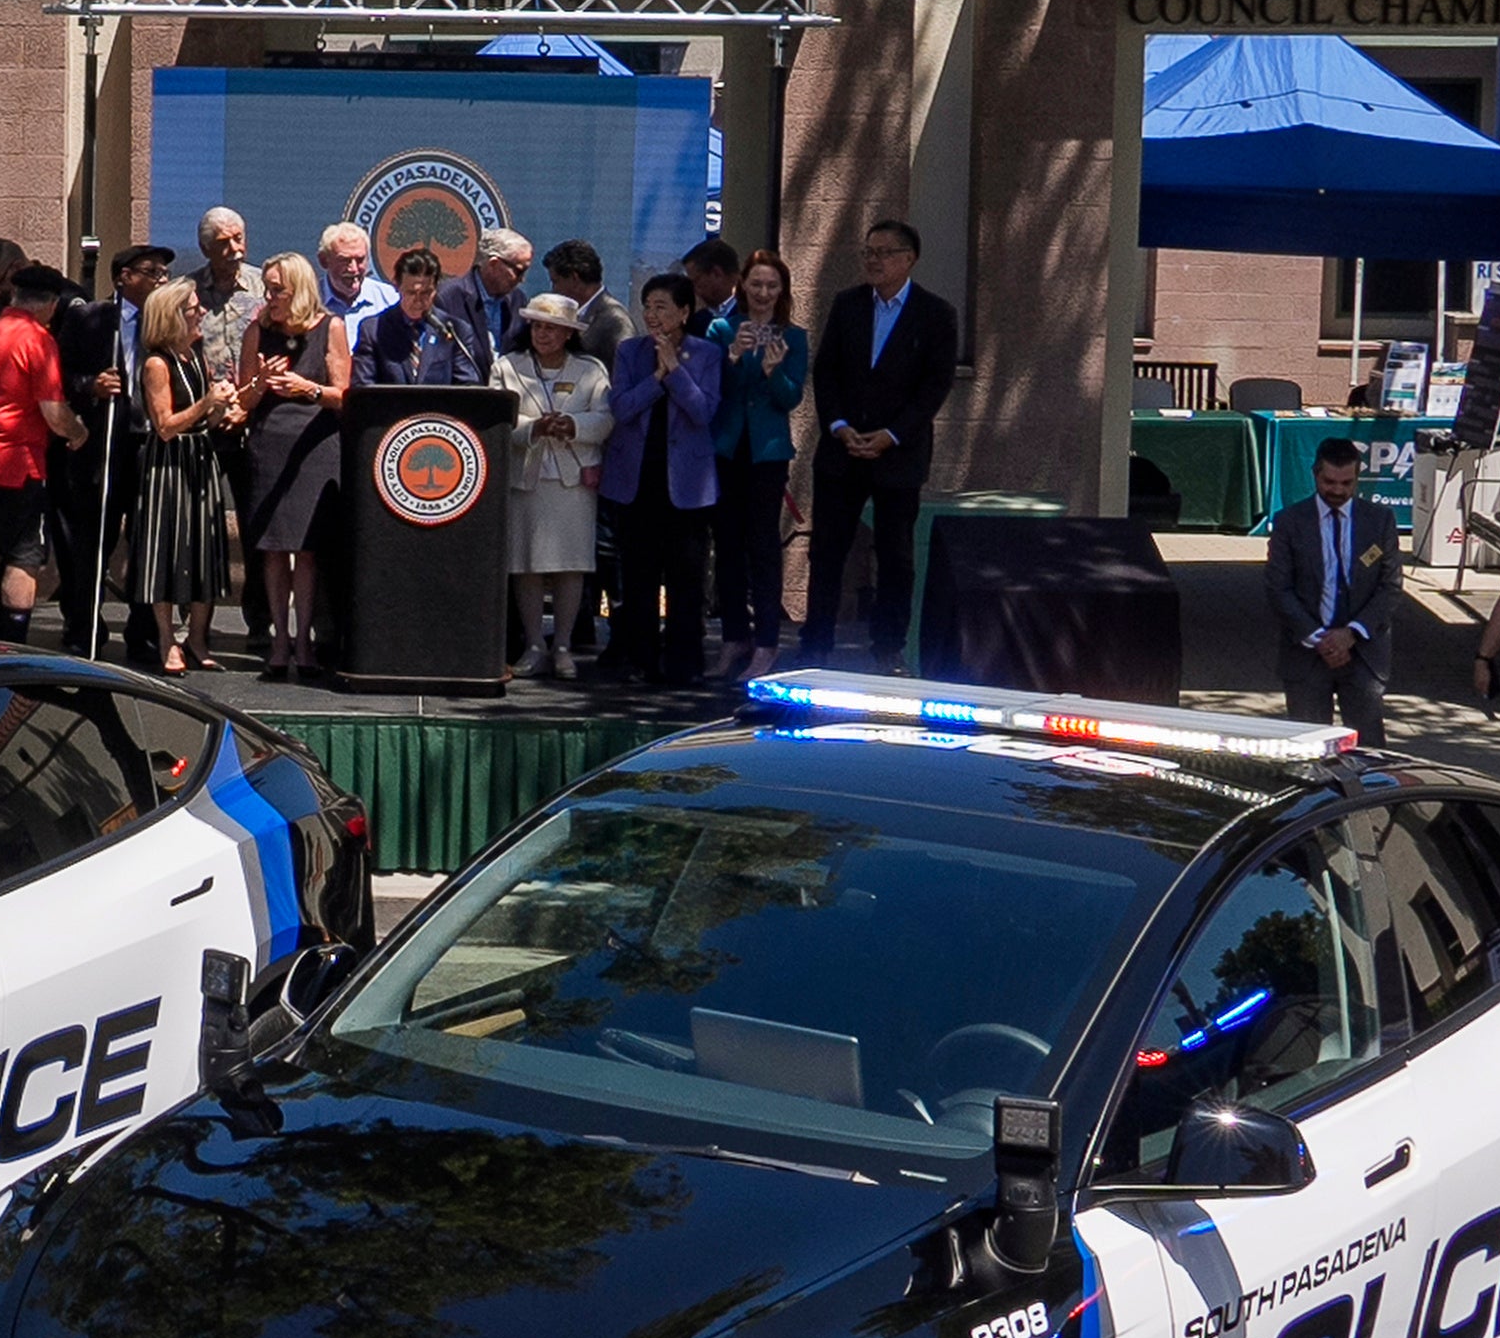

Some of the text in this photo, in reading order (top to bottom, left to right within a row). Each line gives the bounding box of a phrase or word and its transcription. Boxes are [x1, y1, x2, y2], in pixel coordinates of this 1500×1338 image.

[393, 165, 483, 204] PASADENA
[387, 425, 474, 505] CITY OF SOUTH PASADENA CALIFORNIA
[1280, 1217, 1407, 1306] PASADENA
